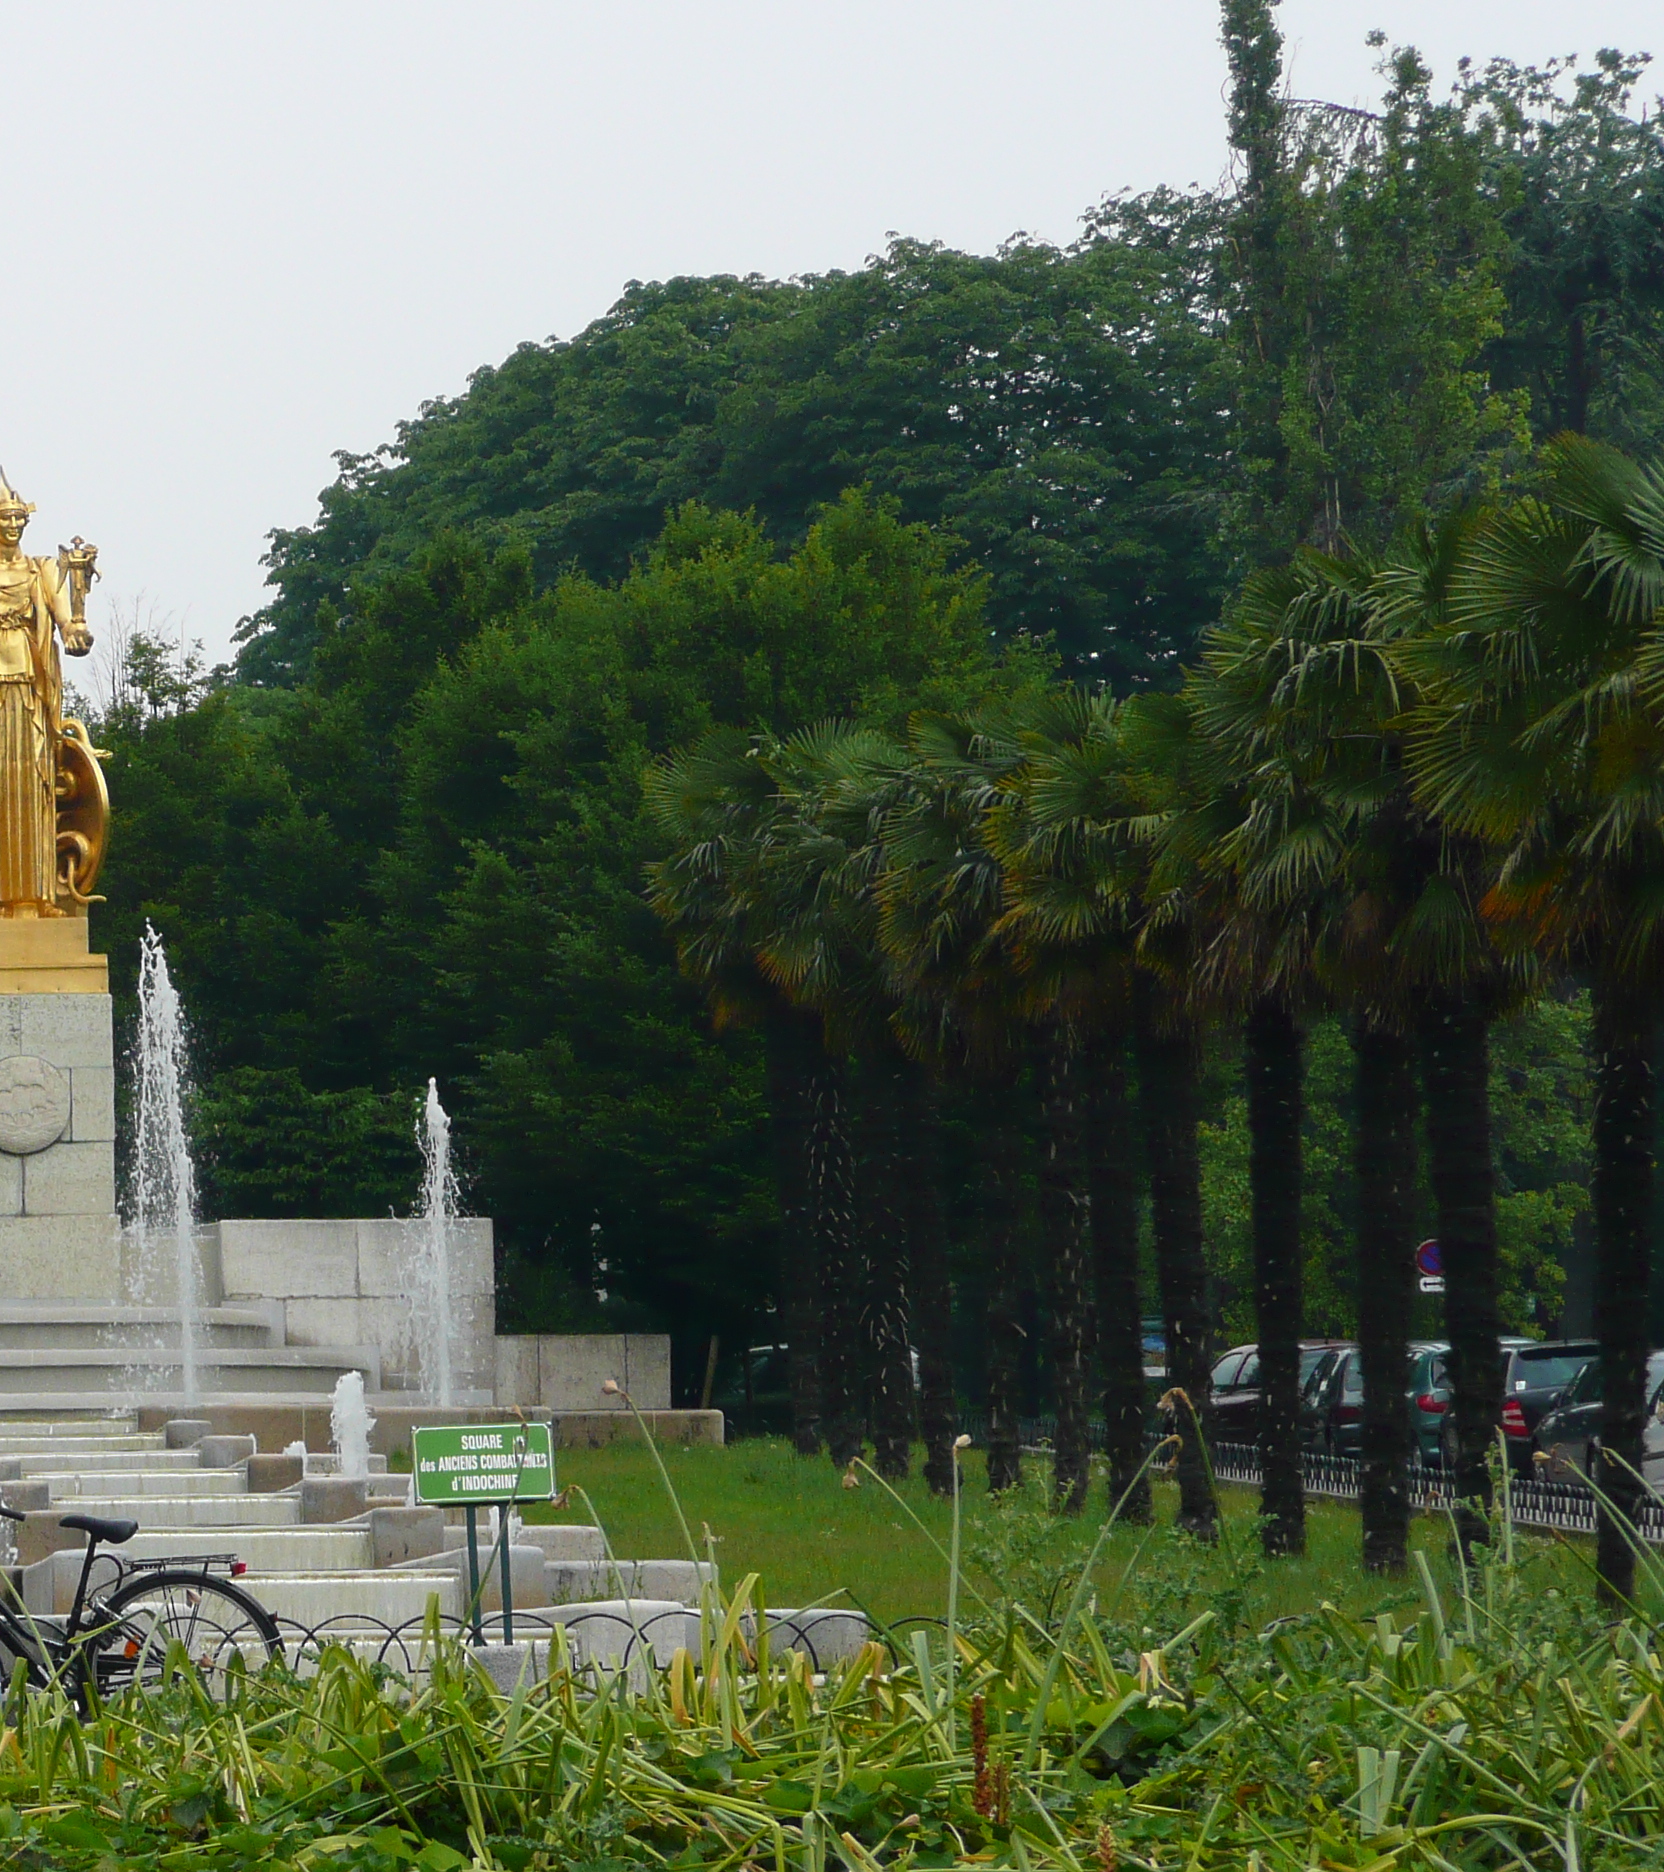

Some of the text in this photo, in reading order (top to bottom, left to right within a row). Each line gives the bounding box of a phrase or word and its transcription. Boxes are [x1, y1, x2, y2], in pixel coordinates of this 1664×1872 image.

[461, 1434, 503, 1450] SQUARE
[420, 1457, 436, 1473] des
[438, 1455, 478, 1472] ANCIENS
